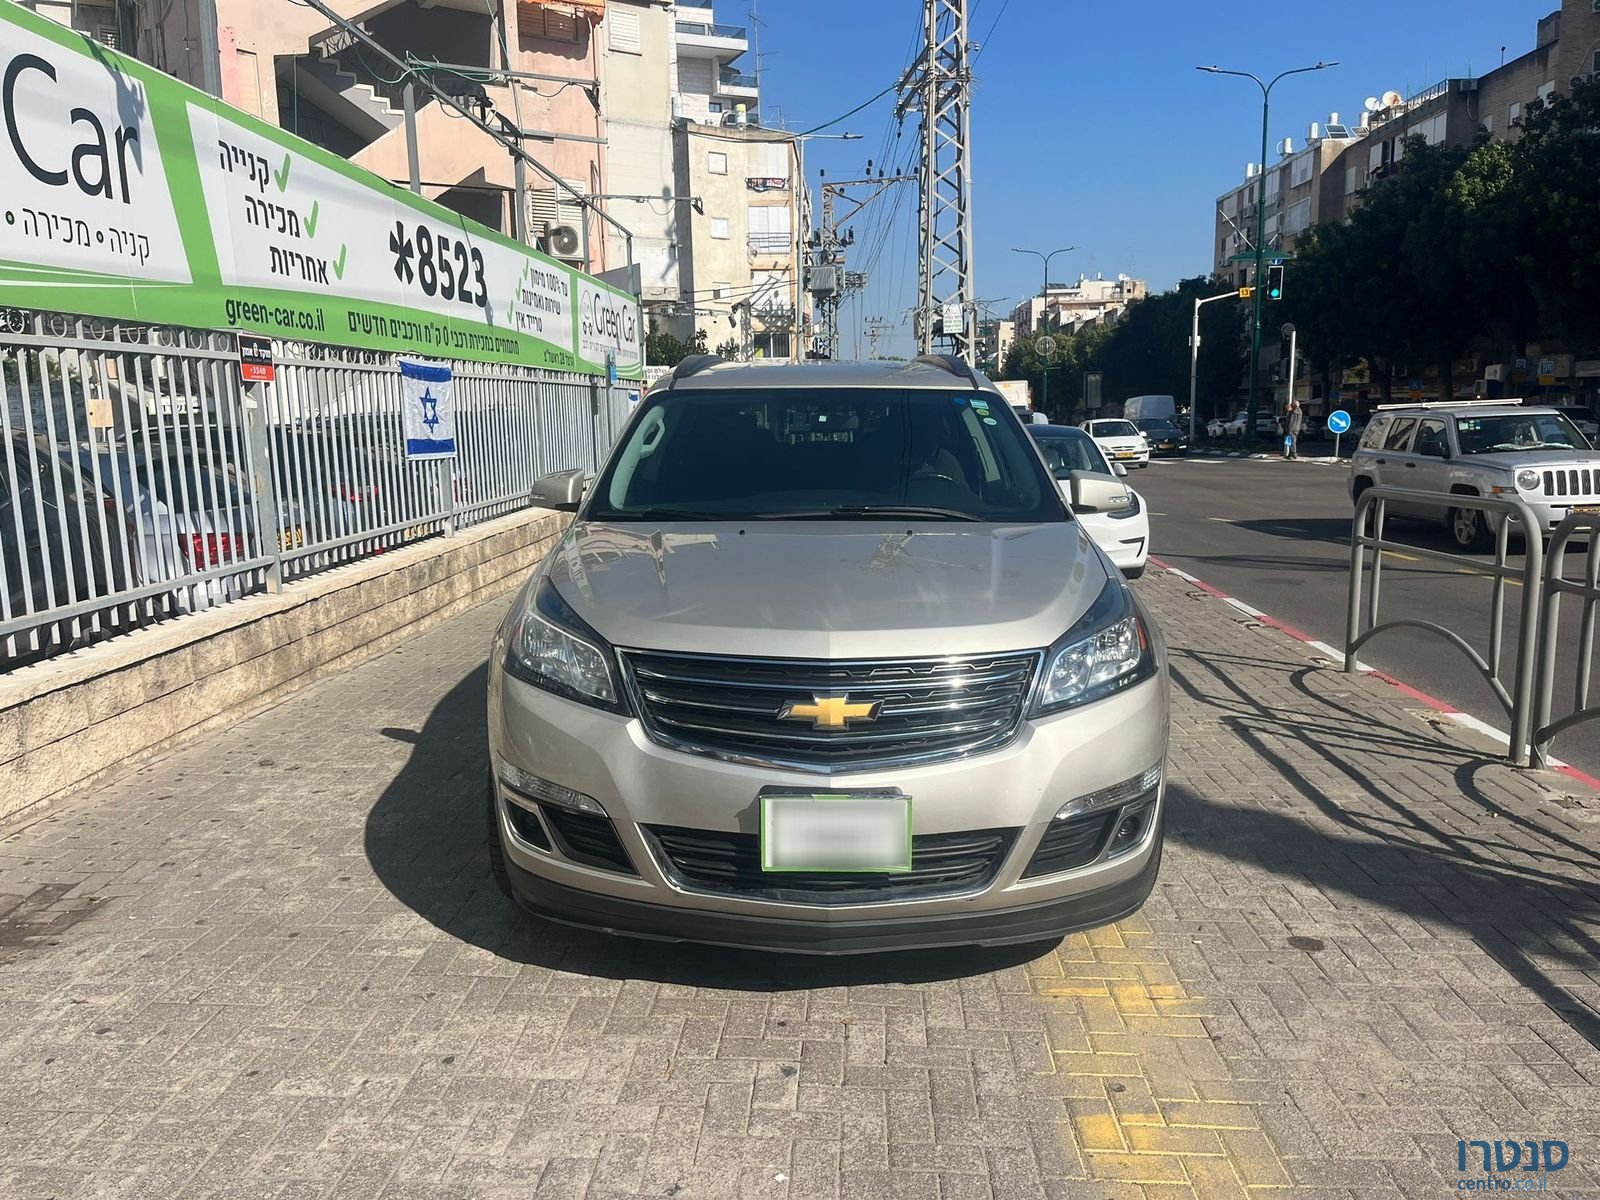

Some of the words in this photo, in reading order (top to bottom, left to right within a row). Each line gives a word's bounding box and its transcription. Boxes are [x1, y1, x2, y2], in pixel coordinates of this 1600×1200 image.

[3, 53, 139, 204] Car
[218, 140, 270, 193] קנייה
[23, 208, 91, 247] מכירה
[245, 195, 300, 238] מכירה
[109, 228, 150, 266] קניה
[270, 246, 329, 285] אחריות
[225, 299, 325, 331] green-car.co.il
[348, 311, 387, 337] חדשים
[390, 319, 422, 342] ורכבים
[593, 293, 622, 340] Green
[622, 304, 636, 343] Car
[451, 331, 468, 349] רכבי
